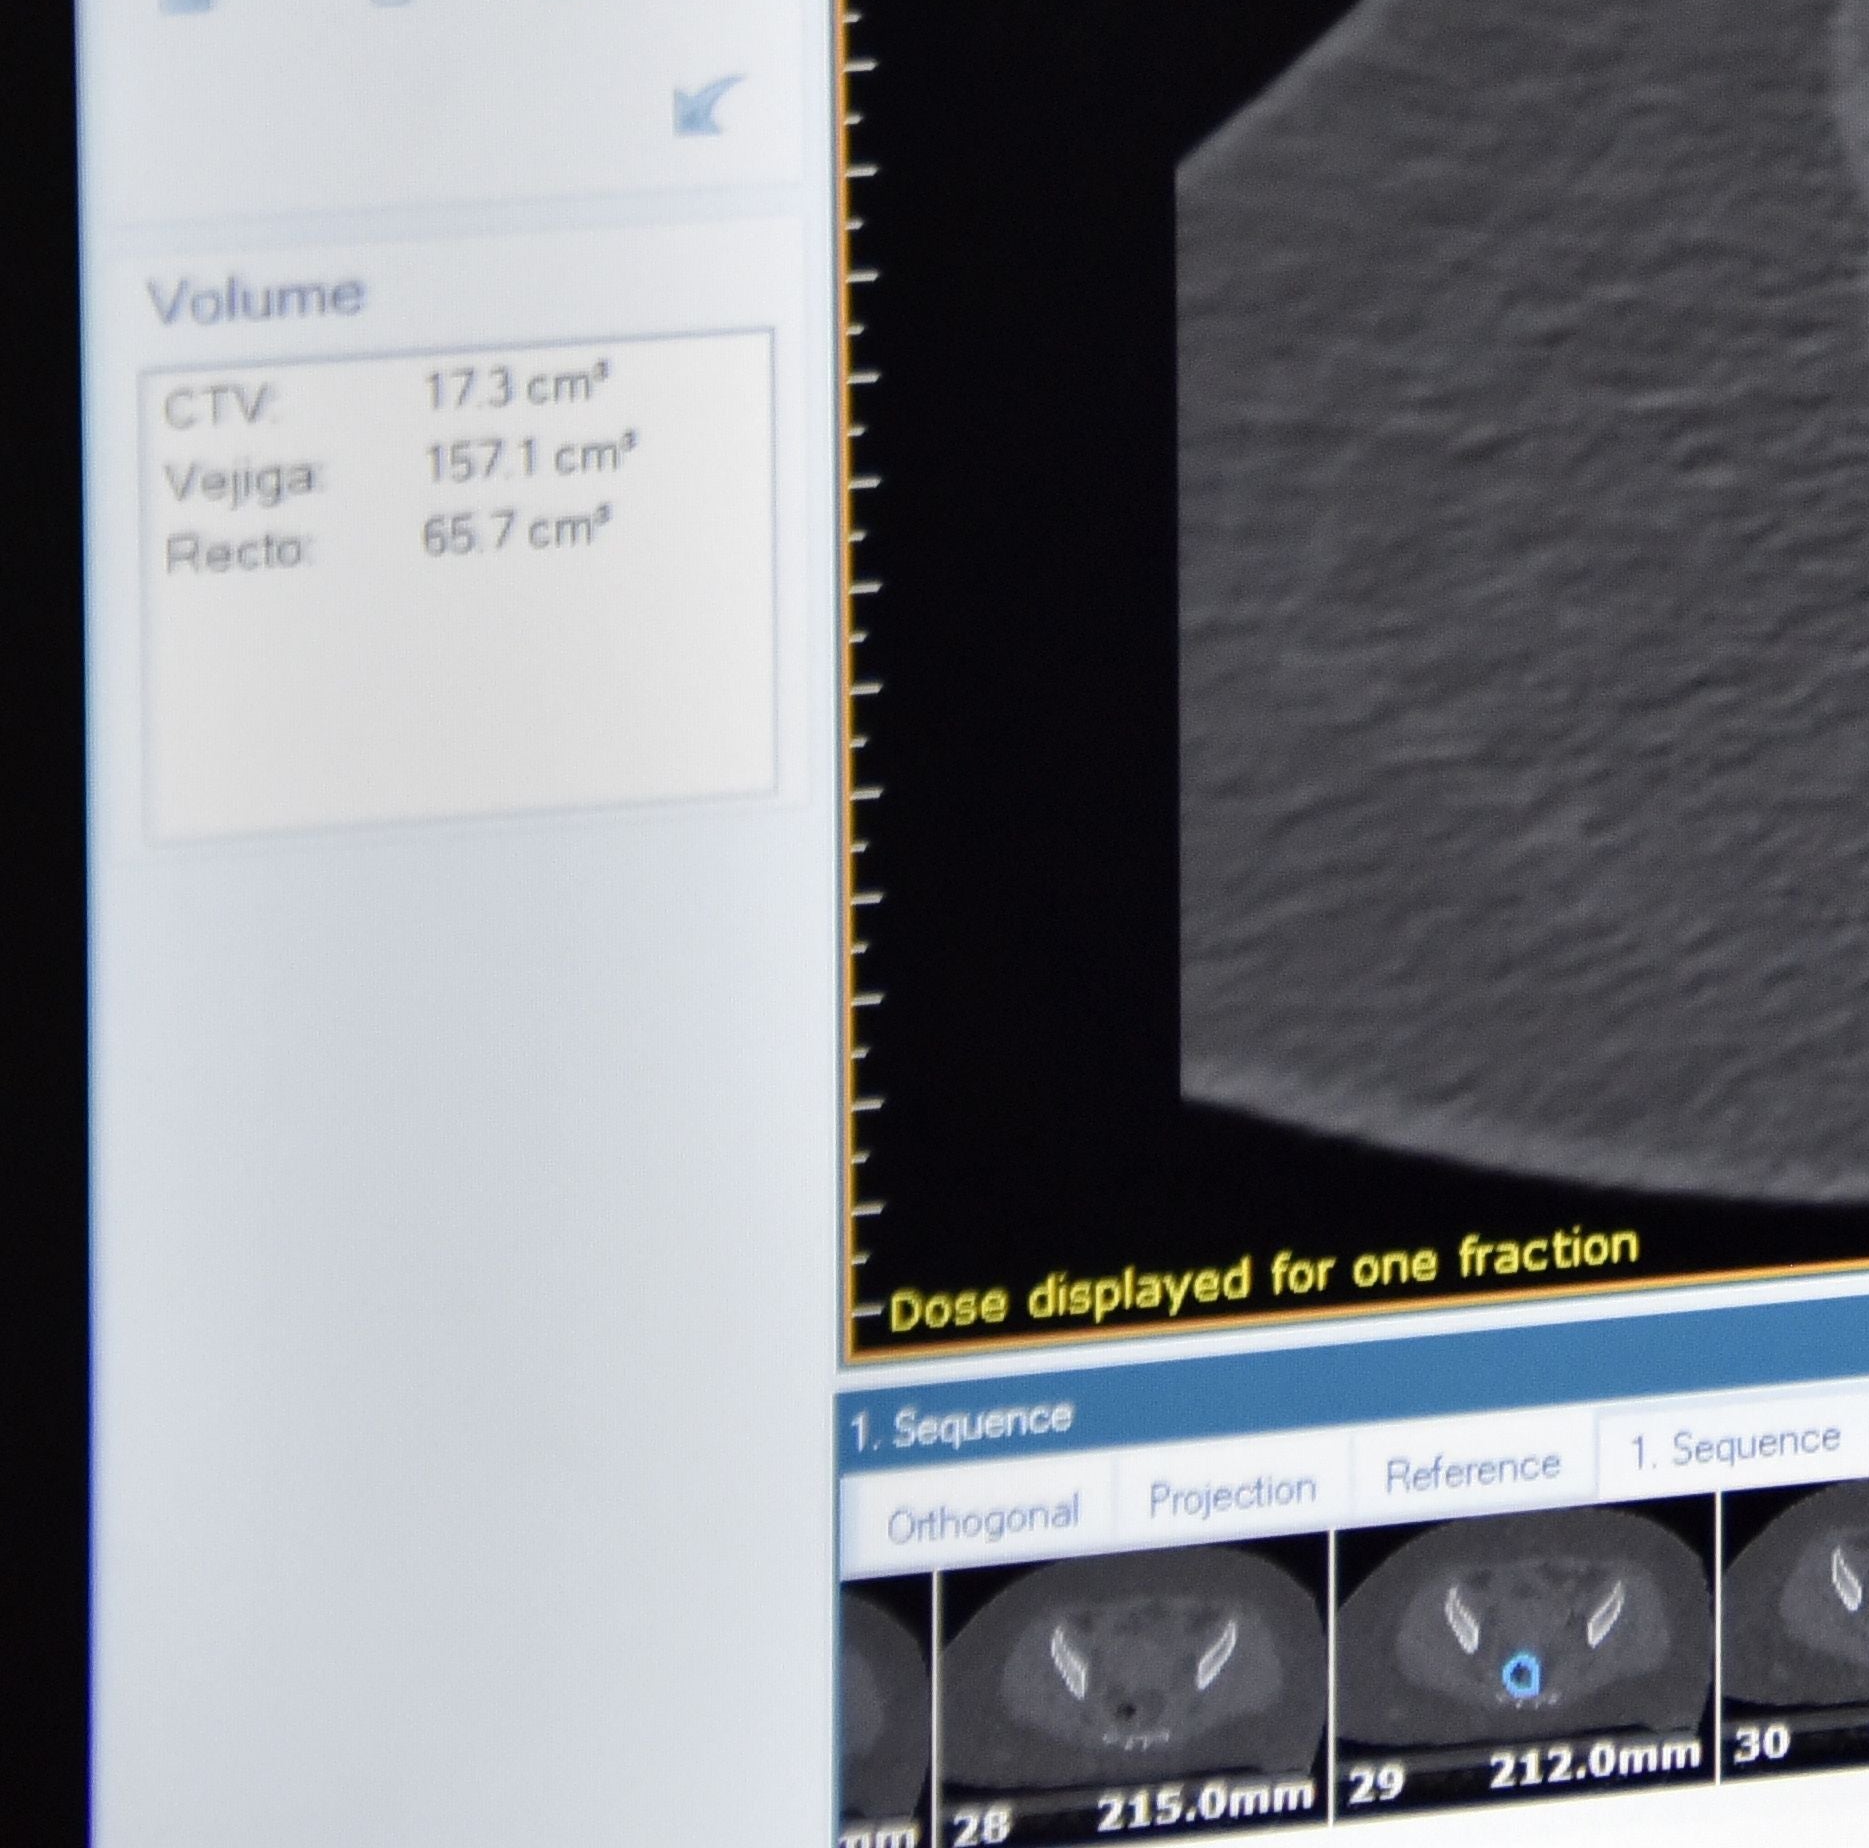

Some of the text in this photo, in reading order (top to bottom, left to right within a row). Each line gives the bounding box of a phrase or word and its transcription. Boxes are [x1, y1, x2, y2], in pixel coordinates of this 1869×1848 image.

[147, 275, 367, 326] Volume
[425, 364, 513, 411] 17.3
[163, 460, 323, 512] Vejiga:
[425, 436, 538, 484] 157.1
[164, 531, 314, 575] Recto:
[422, 508, 517, 558] 65.7
[890, 1225, 1640, 1332] Dose displayed for one fraction
[849, 1399, 1076, 1453] 1. Sequence
[1632, 1422, 1842, 1472] 1. Sequence
[1149, 1474, 1318, 1520] Projection
[1384, 1450, 1562, 1495] Reference
[886, 1490, 1081, 1545] Orthogonal
[1732, 1725, 1792, 1764] 30
[1347, 1742, 1702, 1807] 29 212.0mm
[952, 1778, 1316, 1848] 28 215.0mm
